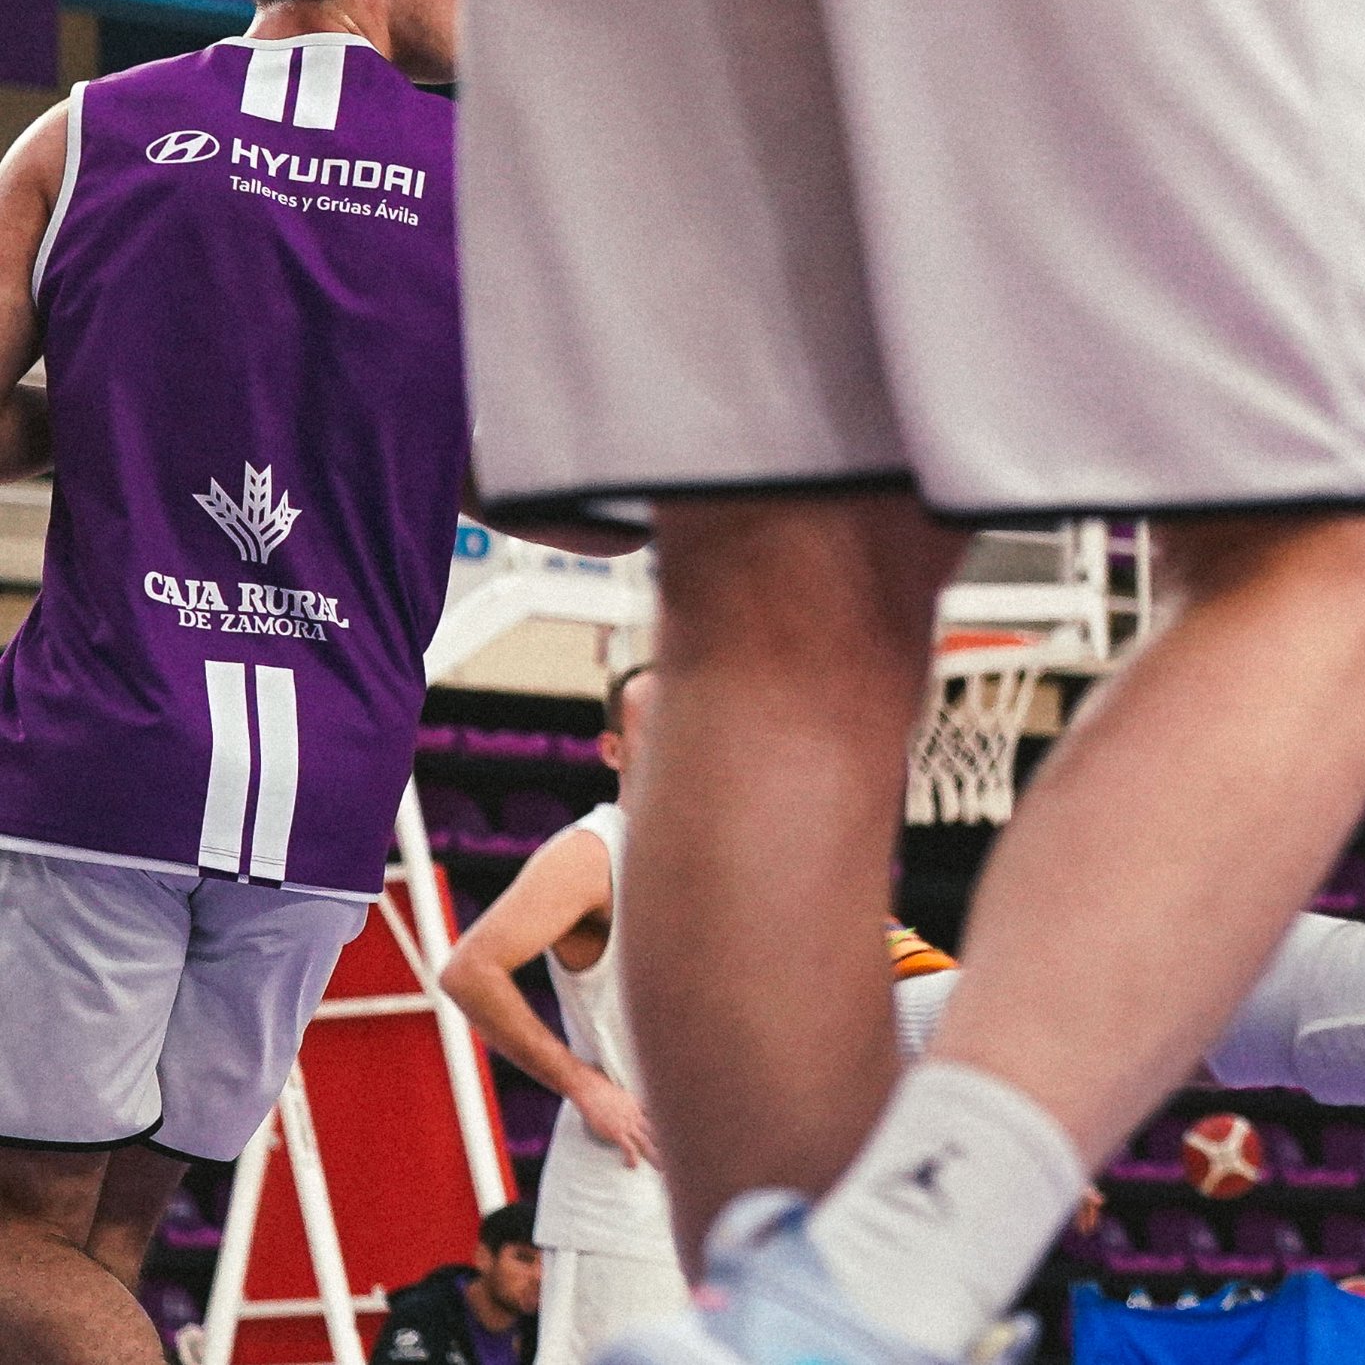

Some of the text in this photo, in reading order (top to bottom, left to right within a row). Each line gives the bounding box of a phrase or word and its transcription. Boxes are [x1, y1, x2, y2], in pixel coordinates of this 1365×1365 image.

[230, 137, 427, 199] HYUNDAI
[229, 175, 420, 227] Talleres y Grúas Ávila
[143, 570, 350, 629] CAJA RURAL
[177, 608, 329, 642] DE ZAMORA
